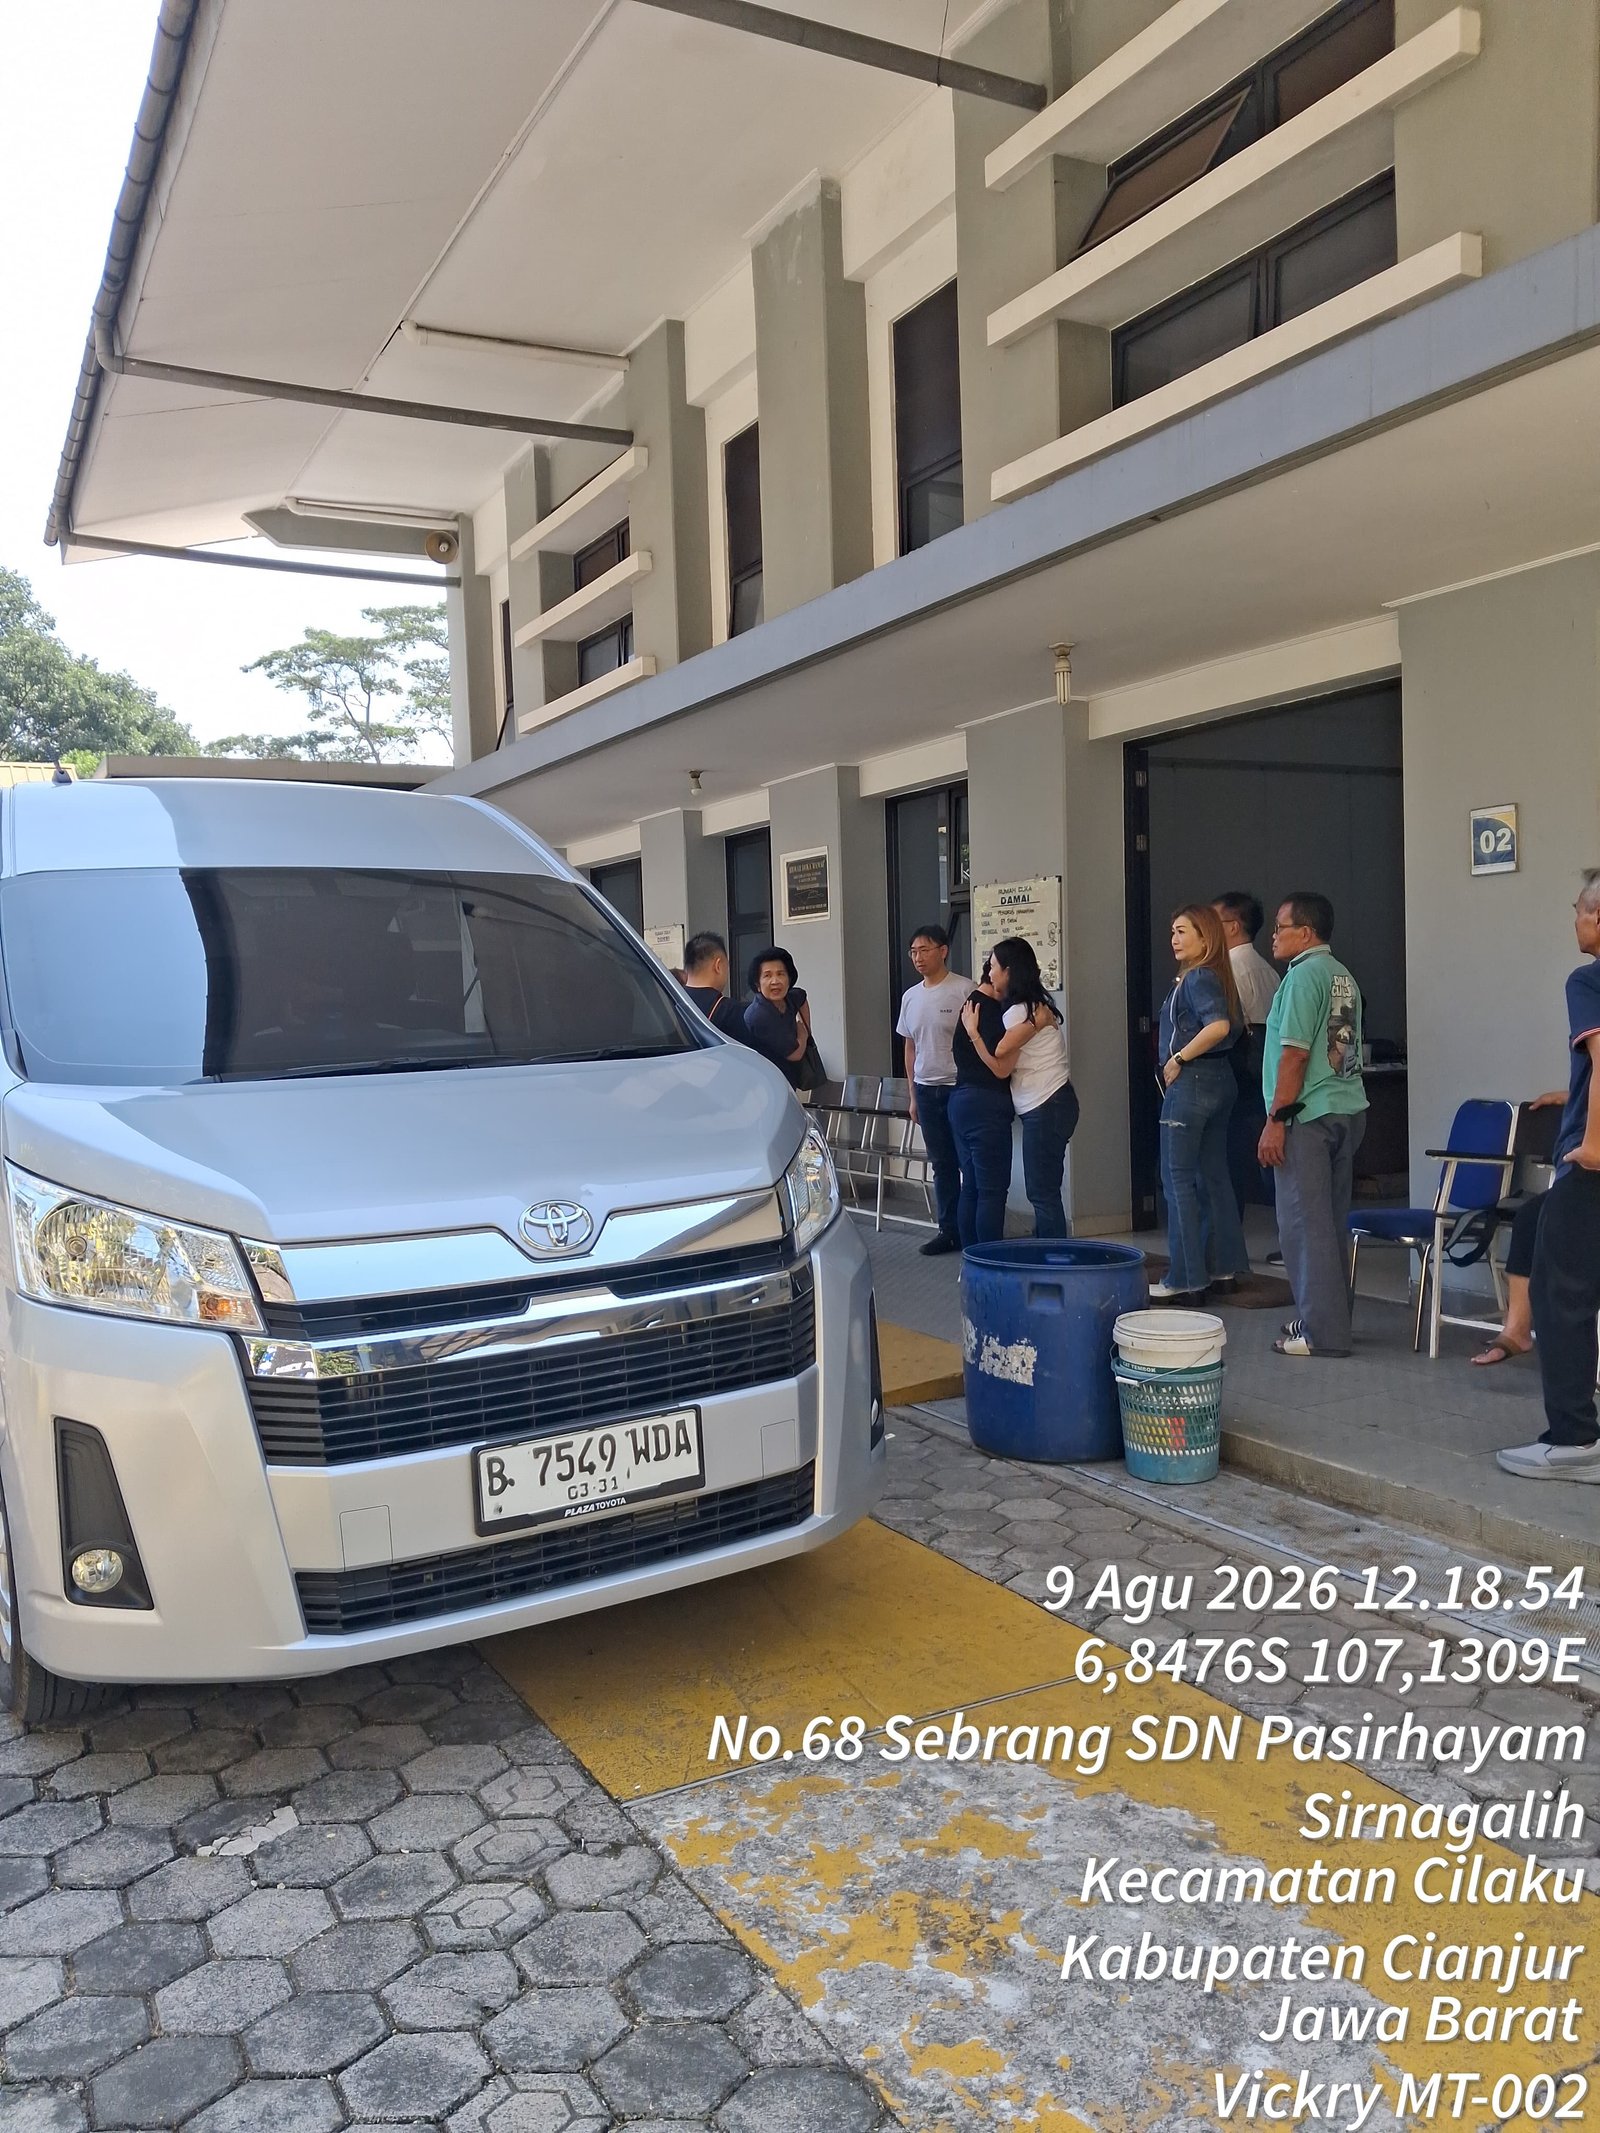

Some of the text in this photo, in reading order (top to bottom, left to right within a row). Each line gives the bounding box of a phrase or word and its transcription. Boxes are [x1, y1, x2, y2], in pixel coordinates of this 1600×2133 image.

[1479, 827, 1512, 854] 02
[1000, 895, 1030, 905] DAMAI
[1131, 1364, 1156, 1373] TEMBOK
[486, 1418, 693, 1497] B 7549 WDA
[563, 1496, 627, 1518] PLAZA TOYOTA
